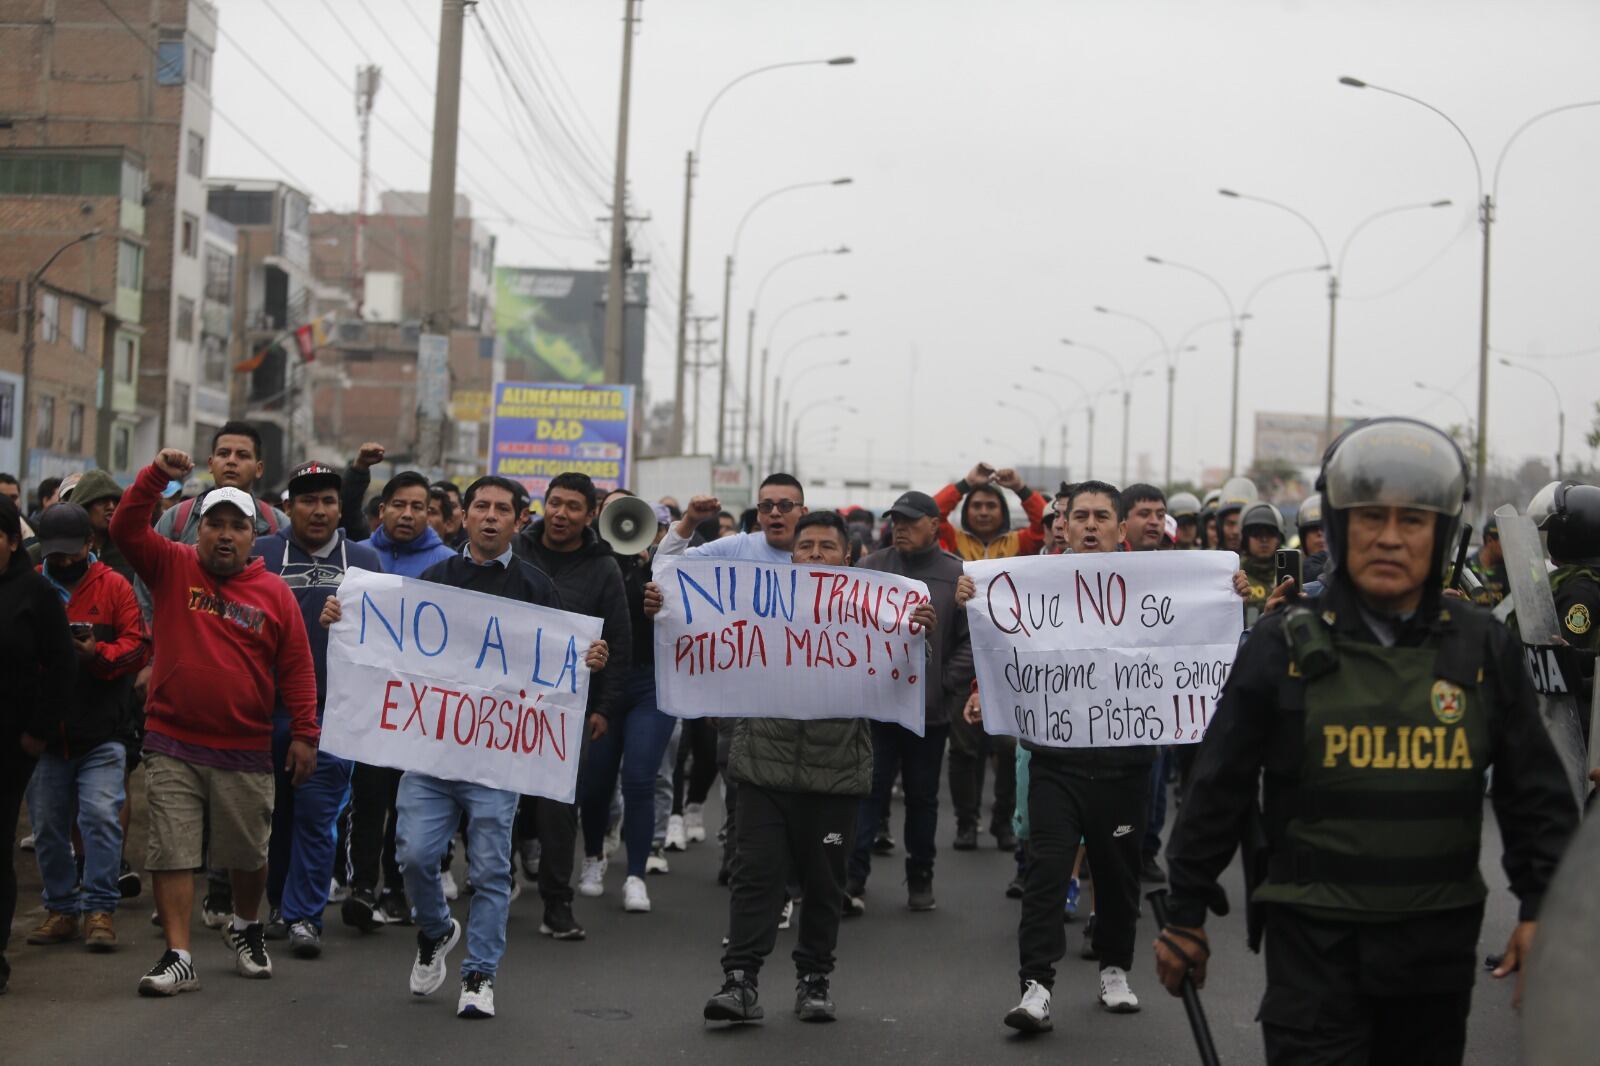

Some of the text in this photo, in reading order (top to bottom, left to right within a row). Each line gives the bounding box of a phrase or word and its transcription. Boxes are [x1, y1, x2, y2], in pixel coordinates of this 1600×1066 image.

[502, 387, 623, 406] ALINEAMIENTO
[536, 419, 584, 440] D&D
[497, 458, 620, 478] AMORTIGUADORES
[676, 566, 737, 625] NI
[753, 567, 797, 622] UN
[986, 569, 1175, 638] Que NO se
[359, 591, 578, 694] NO A LA
[675, 619, 767, 677] RTISTA
[1004, 646, 1232, 700] derrame más sangr
[1014, 704, 1037, 737] en
[1044, 694, 1073, 742] las
[1322, 725, 1473, 769] POLICIA
